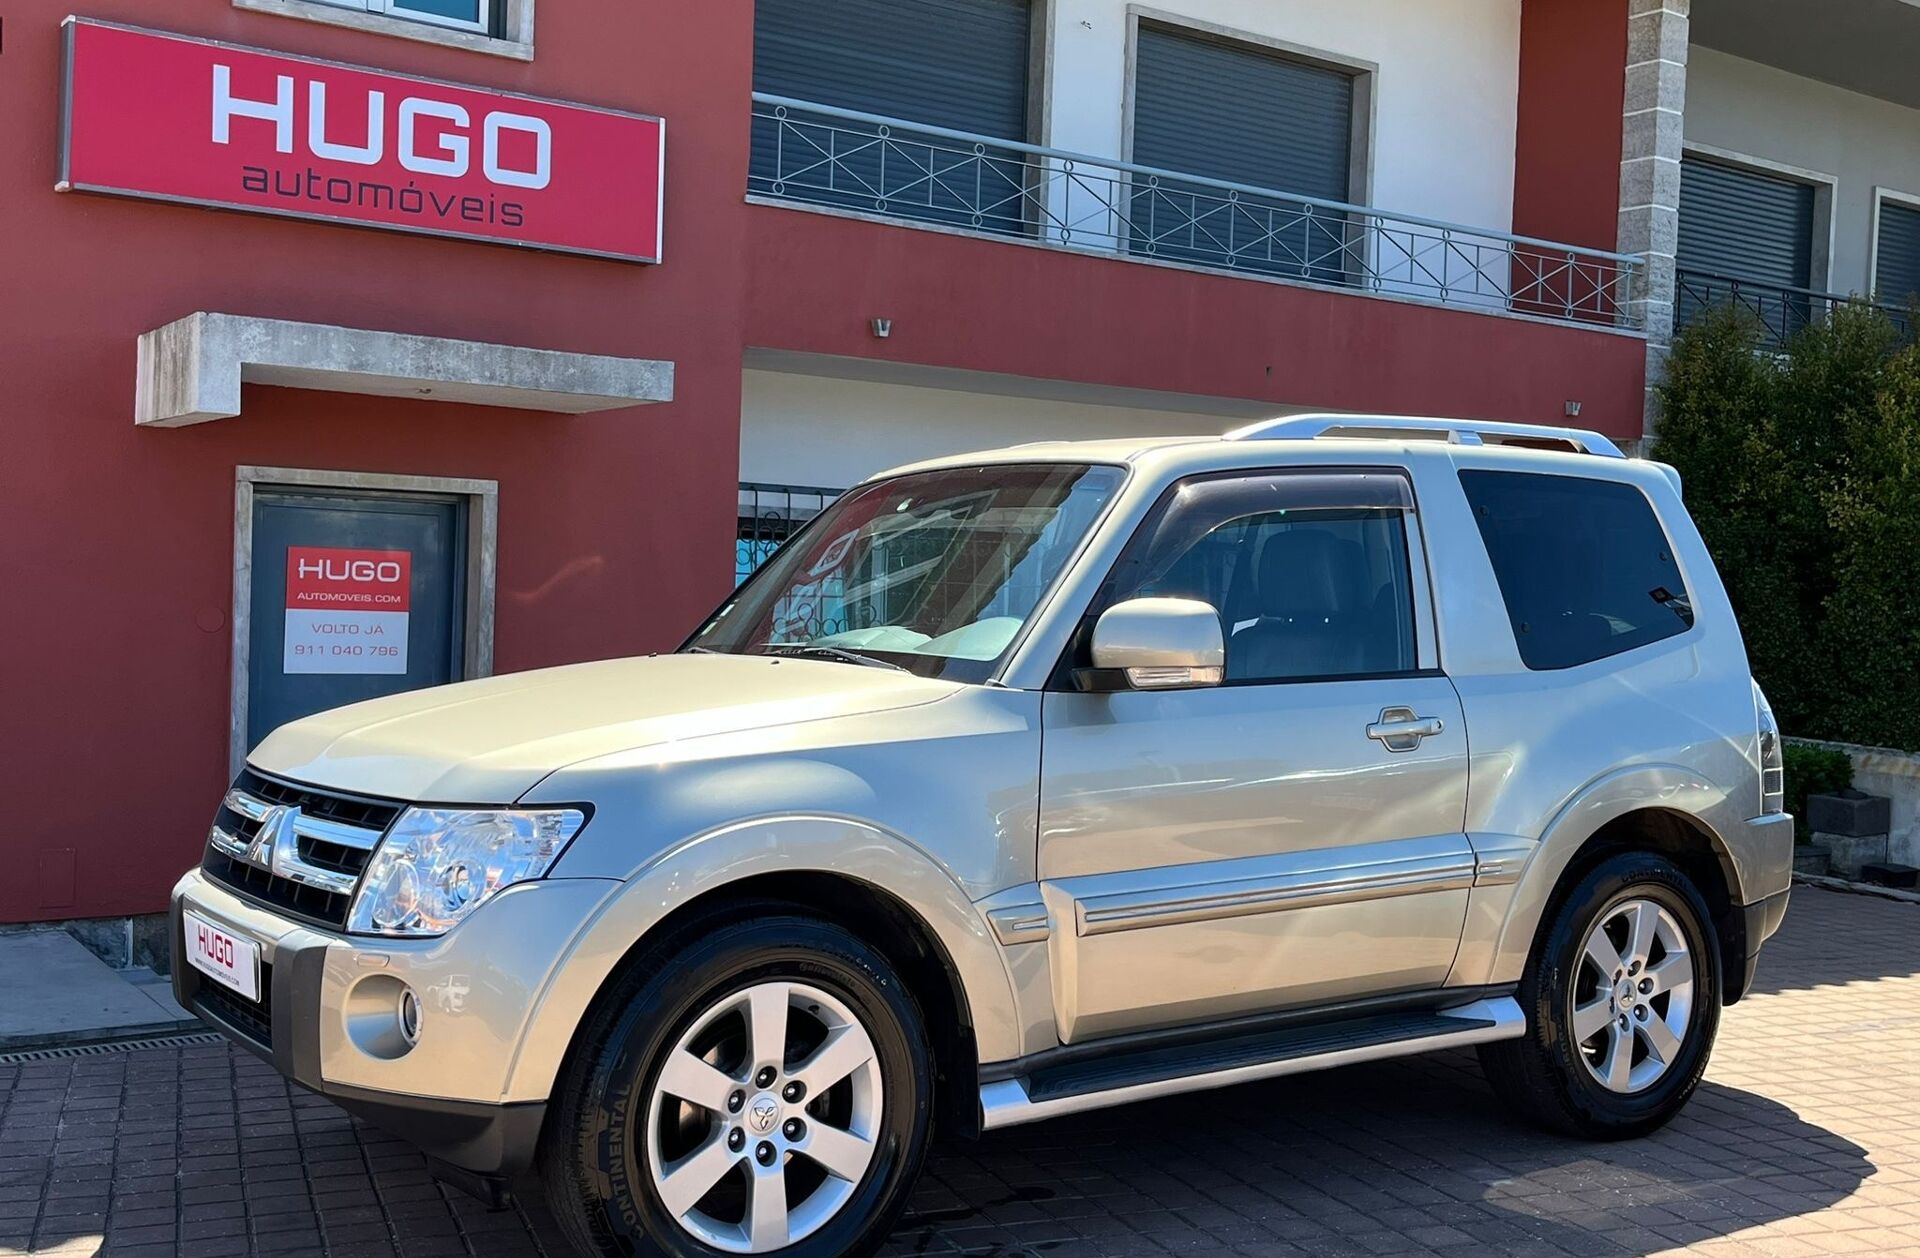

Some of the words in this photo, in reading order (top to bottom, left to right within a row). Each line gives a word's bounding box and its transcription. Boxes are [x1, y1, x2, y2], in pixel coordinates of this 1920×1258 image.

[211, 63, 552, 190] HUGO
[242, 165, 524, 227] automóveis
[298, 558, 400, 582] HUGO
[297, 591, 401, 603] AUTOMOVEIS.COM
[311, 623, 360, 635] VOLTO
[294, 644, 325, 656] 911
[331, 645, 363, 656] 040
[369, 646, 399, 656] 796
[197, 923, 234, 969] HUGO
[609, 1083, 645, 1239] CONTINENTAL
